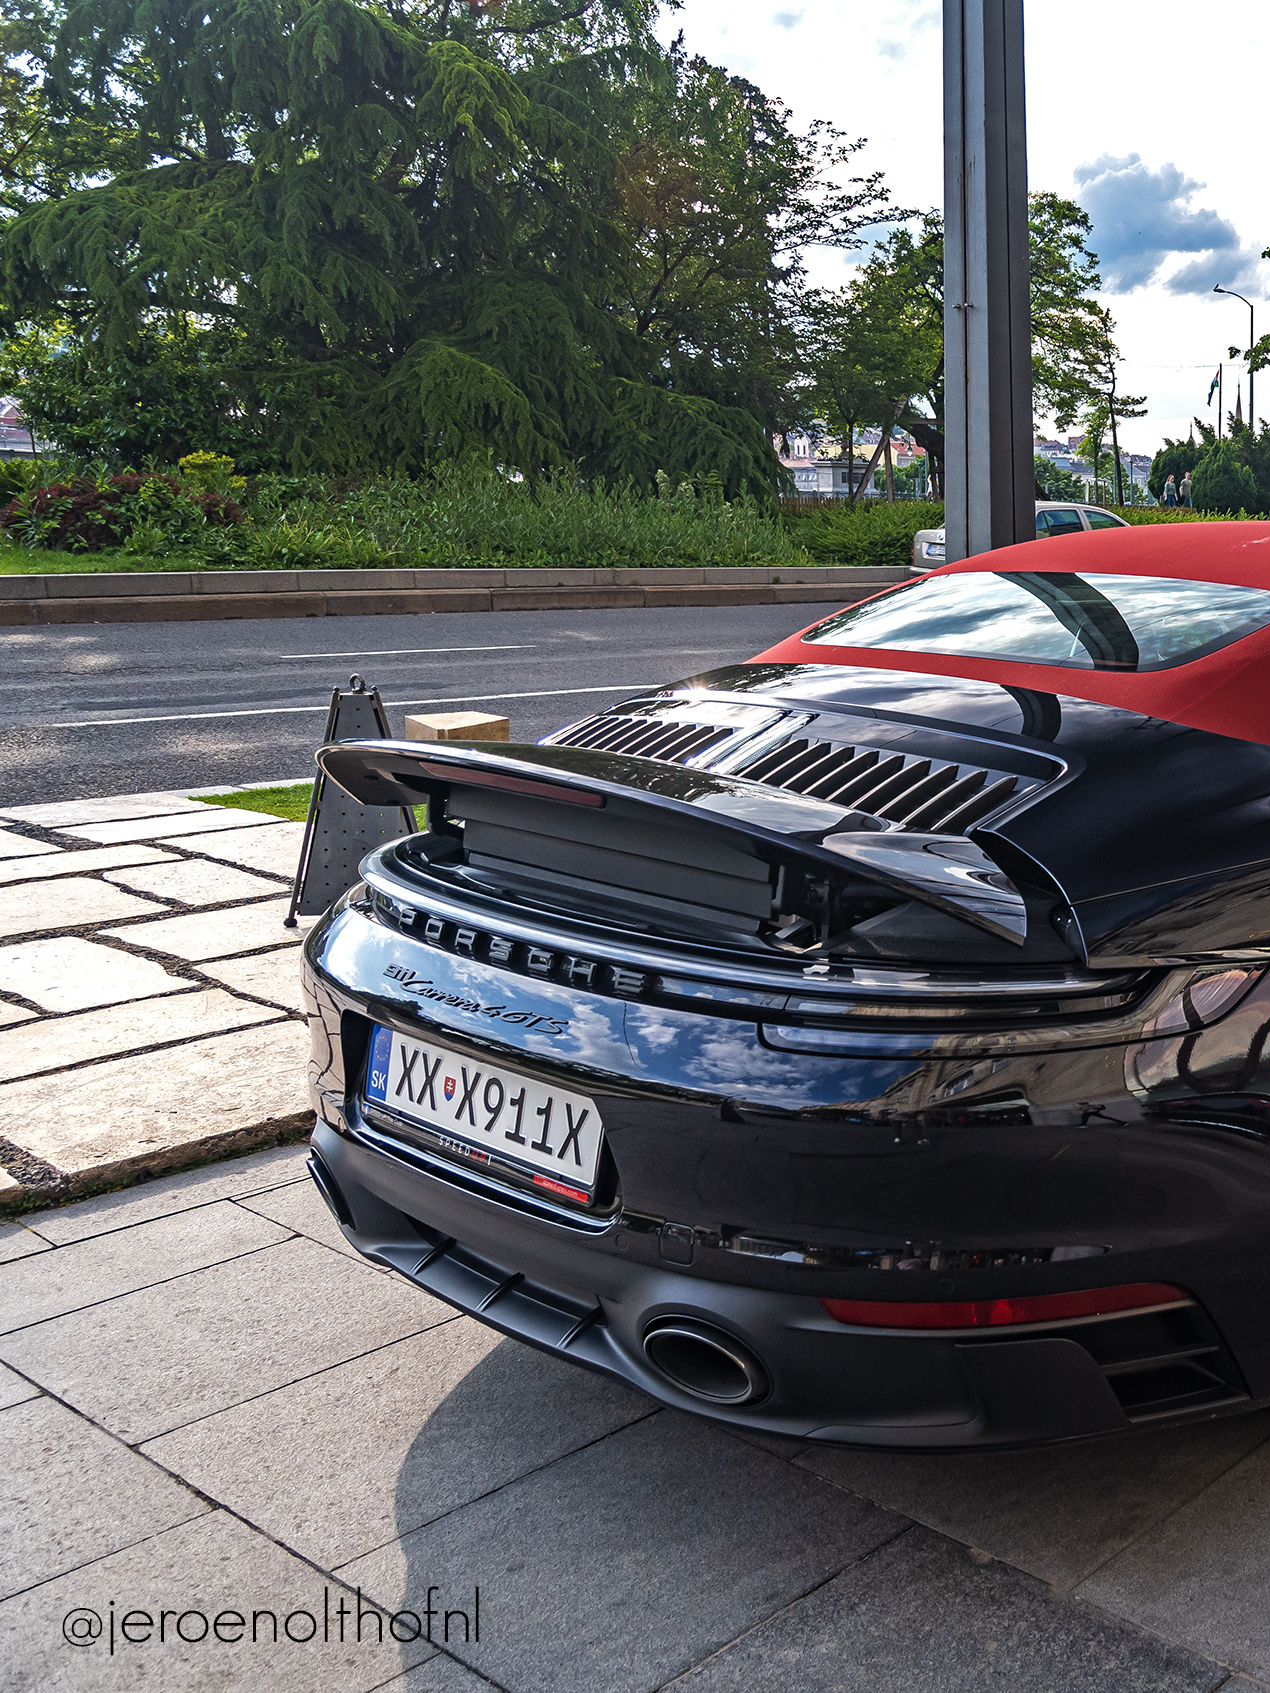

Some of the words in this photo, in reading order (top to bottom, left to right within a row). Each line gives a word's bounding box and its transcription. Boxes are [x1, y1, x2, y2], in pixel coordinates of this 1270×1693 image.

[398, 905, 646, 994] PORSCHE
[399, 979, 481, 1013] Carrera
[480, 1004, 507, 1018] 4
[500, 1010, 569, 1035] GTS
[371, 1069, 386, 1092] SK
[395, 1043, 443, 1112] XX
[455, 1065, 589, 1167] X911X
